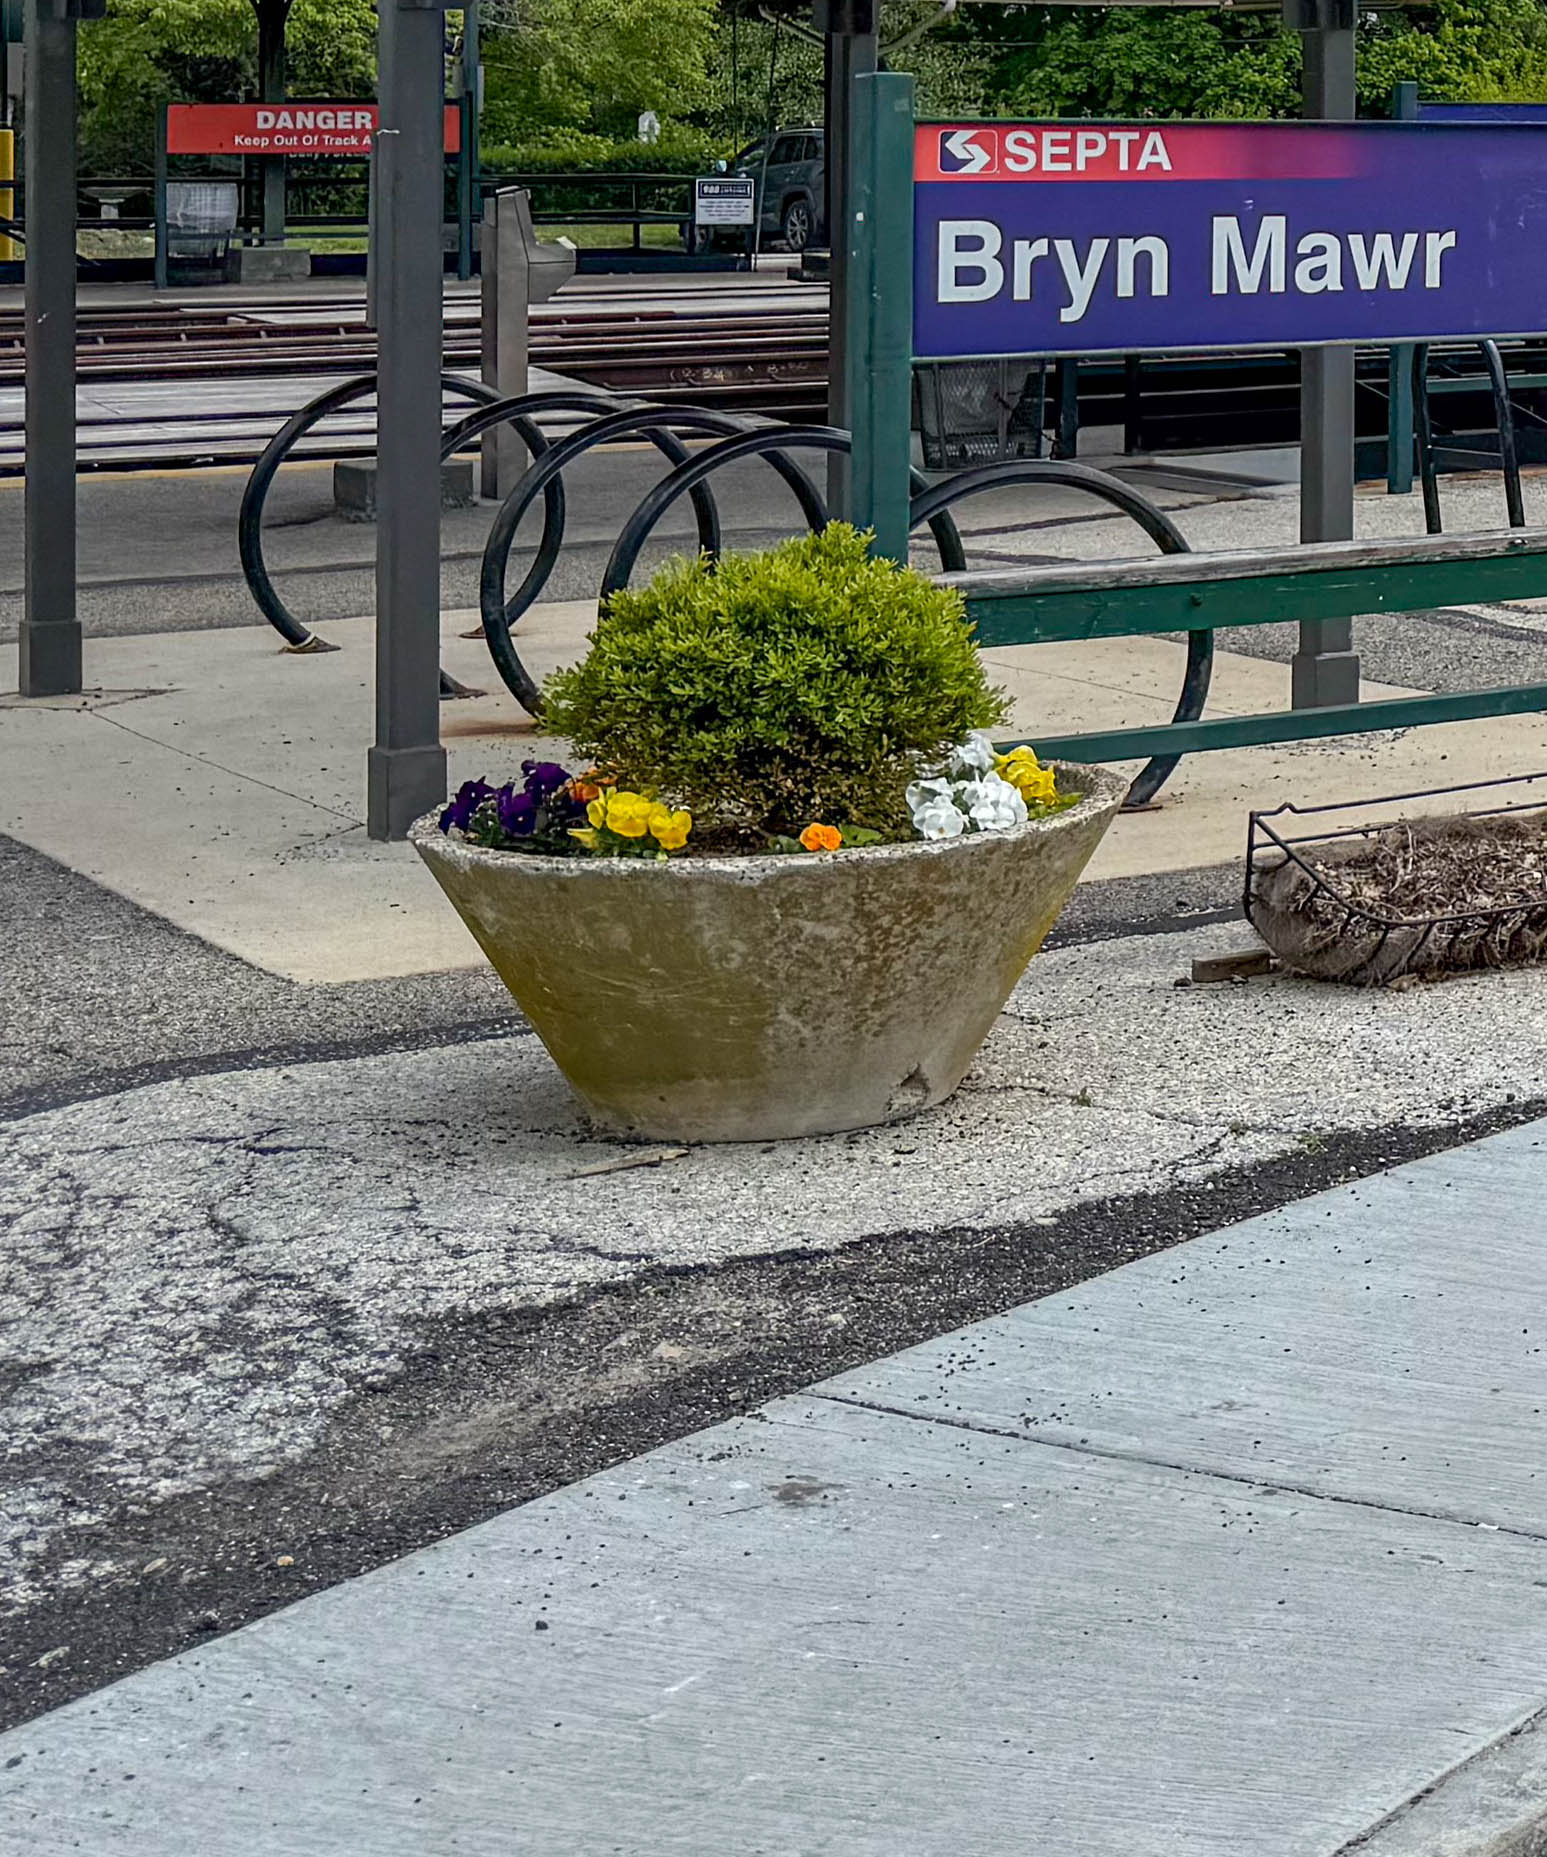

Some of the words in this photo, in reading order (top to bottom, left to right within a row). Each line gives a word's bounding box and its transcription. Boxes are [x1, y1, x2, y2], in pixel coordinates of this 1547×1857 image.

[256, 110, 373, 130] DANGER
[234, 134, 270, 148] Keep
[274, 134, 298, 146] Out
[302, 134, 319, 146] Of
[323, 134, 359, 146] Track
[1004, 130, 1173, 173] SEPTA
[936, 219, 1170, 324] Bryn
[1211, 214, 1457, 295] Mawr
